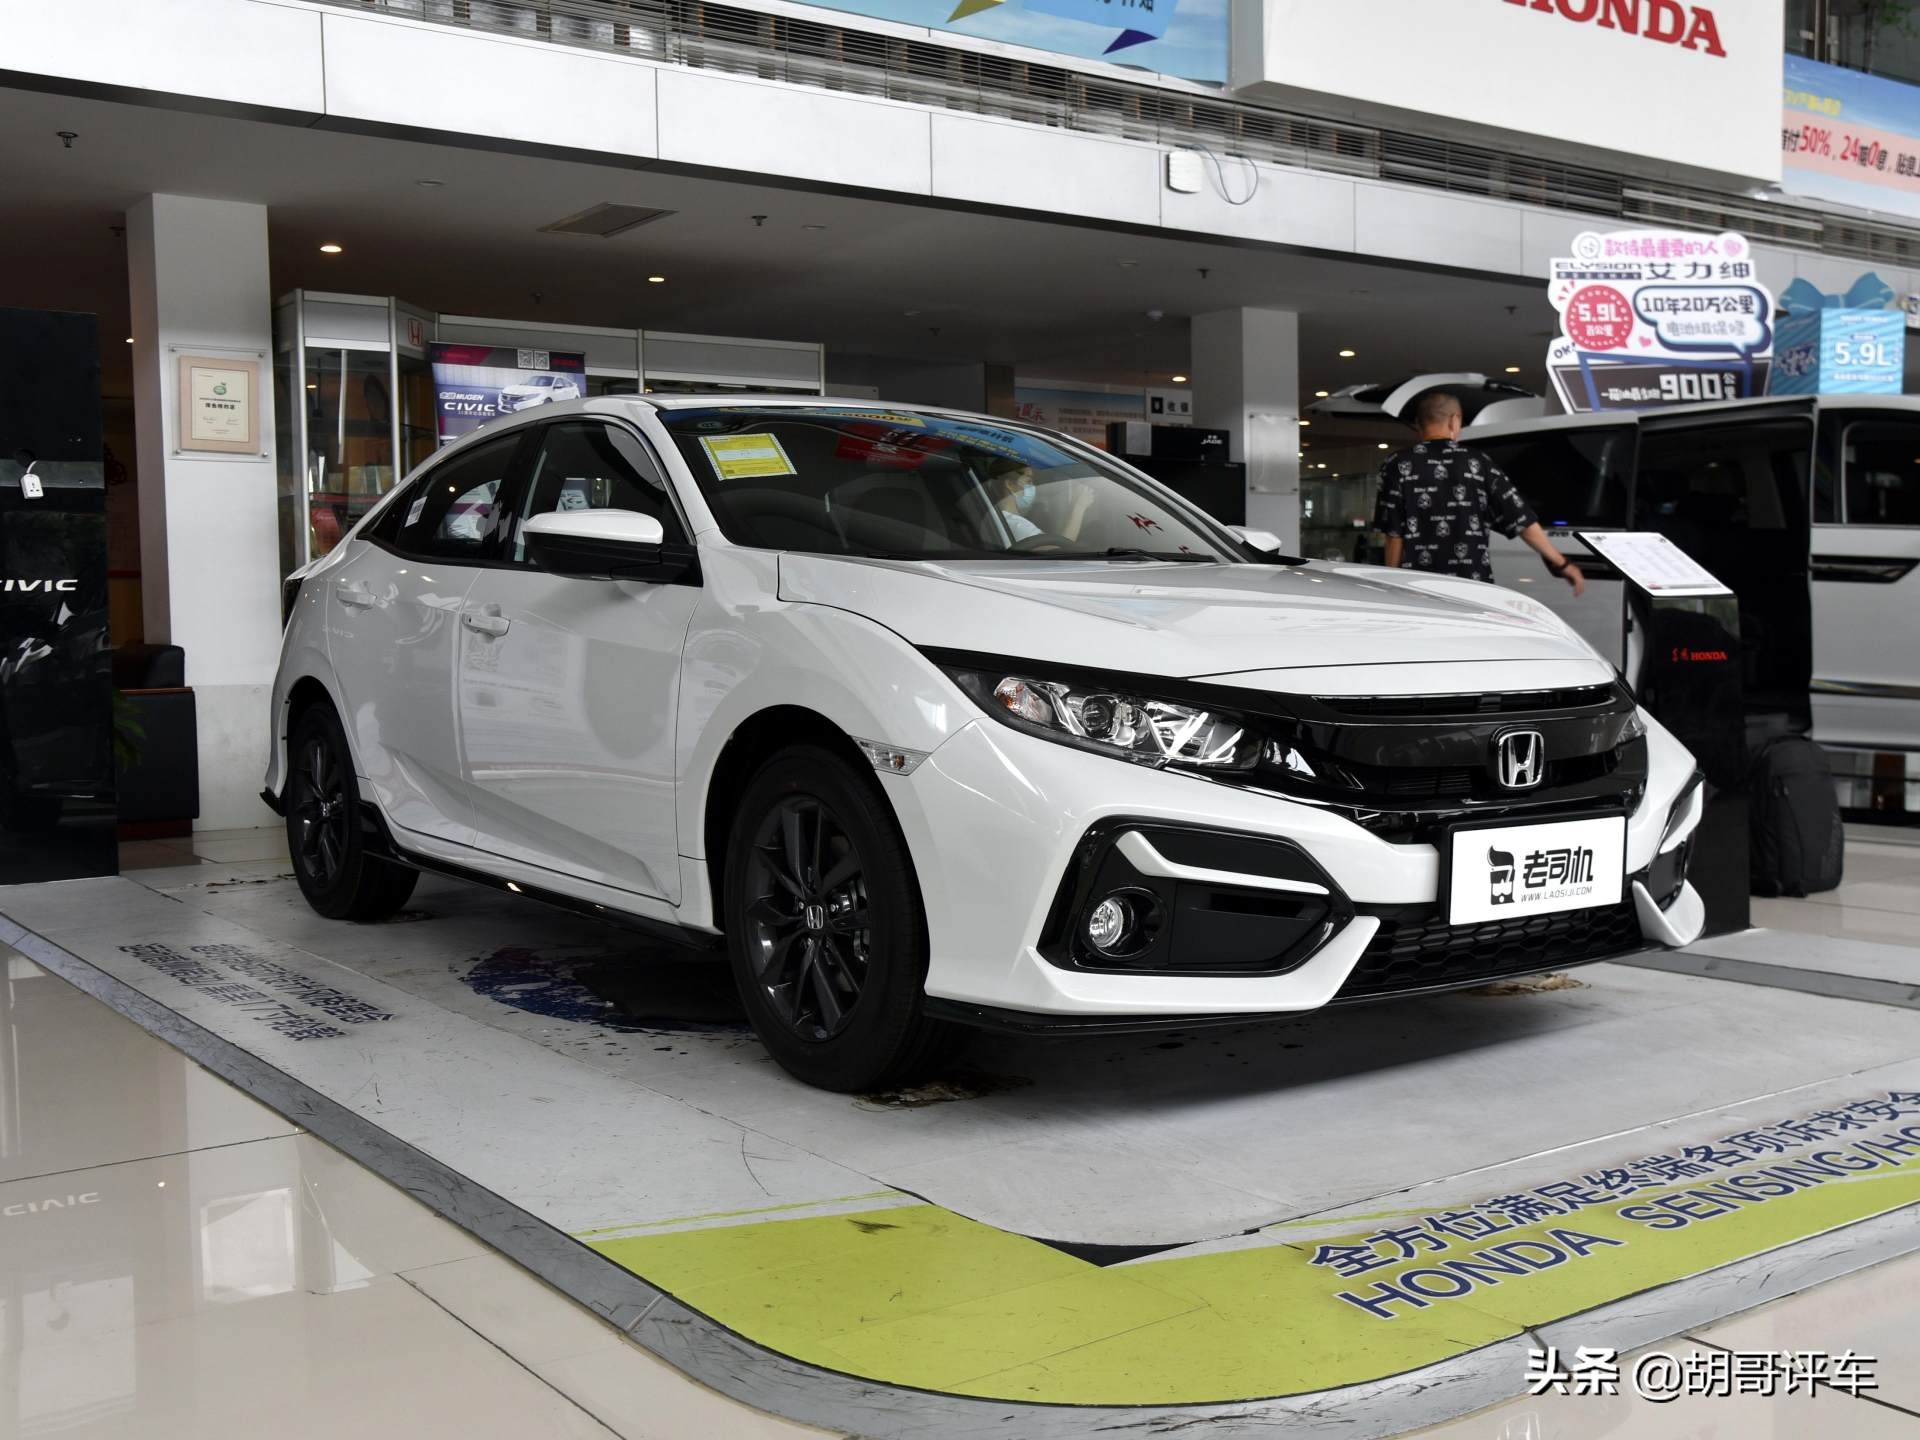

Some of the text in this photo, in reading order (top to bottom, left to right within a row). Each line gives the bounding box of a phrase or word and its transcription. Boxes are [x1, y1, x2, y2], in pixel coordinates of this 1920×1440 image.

[1504, 0, 1727, 57] ONDA
[1604, 238, 1719, 257] 款待最重要的人
[1644, 262, 1750, 280] 艾力绅
[1577, 303, 1623, 323] 5.9L
[1643, 295, 1755, 315] 10年20万公里
[1834, 342, 1893, 366] 5.9L
[444, 402, 496, 412] CIVIC
[0, 580, 78, 592] IVIC
[1691, 651, 1728, 660] HONDA
[1523, 846, 1593, 888] 老司机
[1338, 1229, 1622, 1318] HONDA
